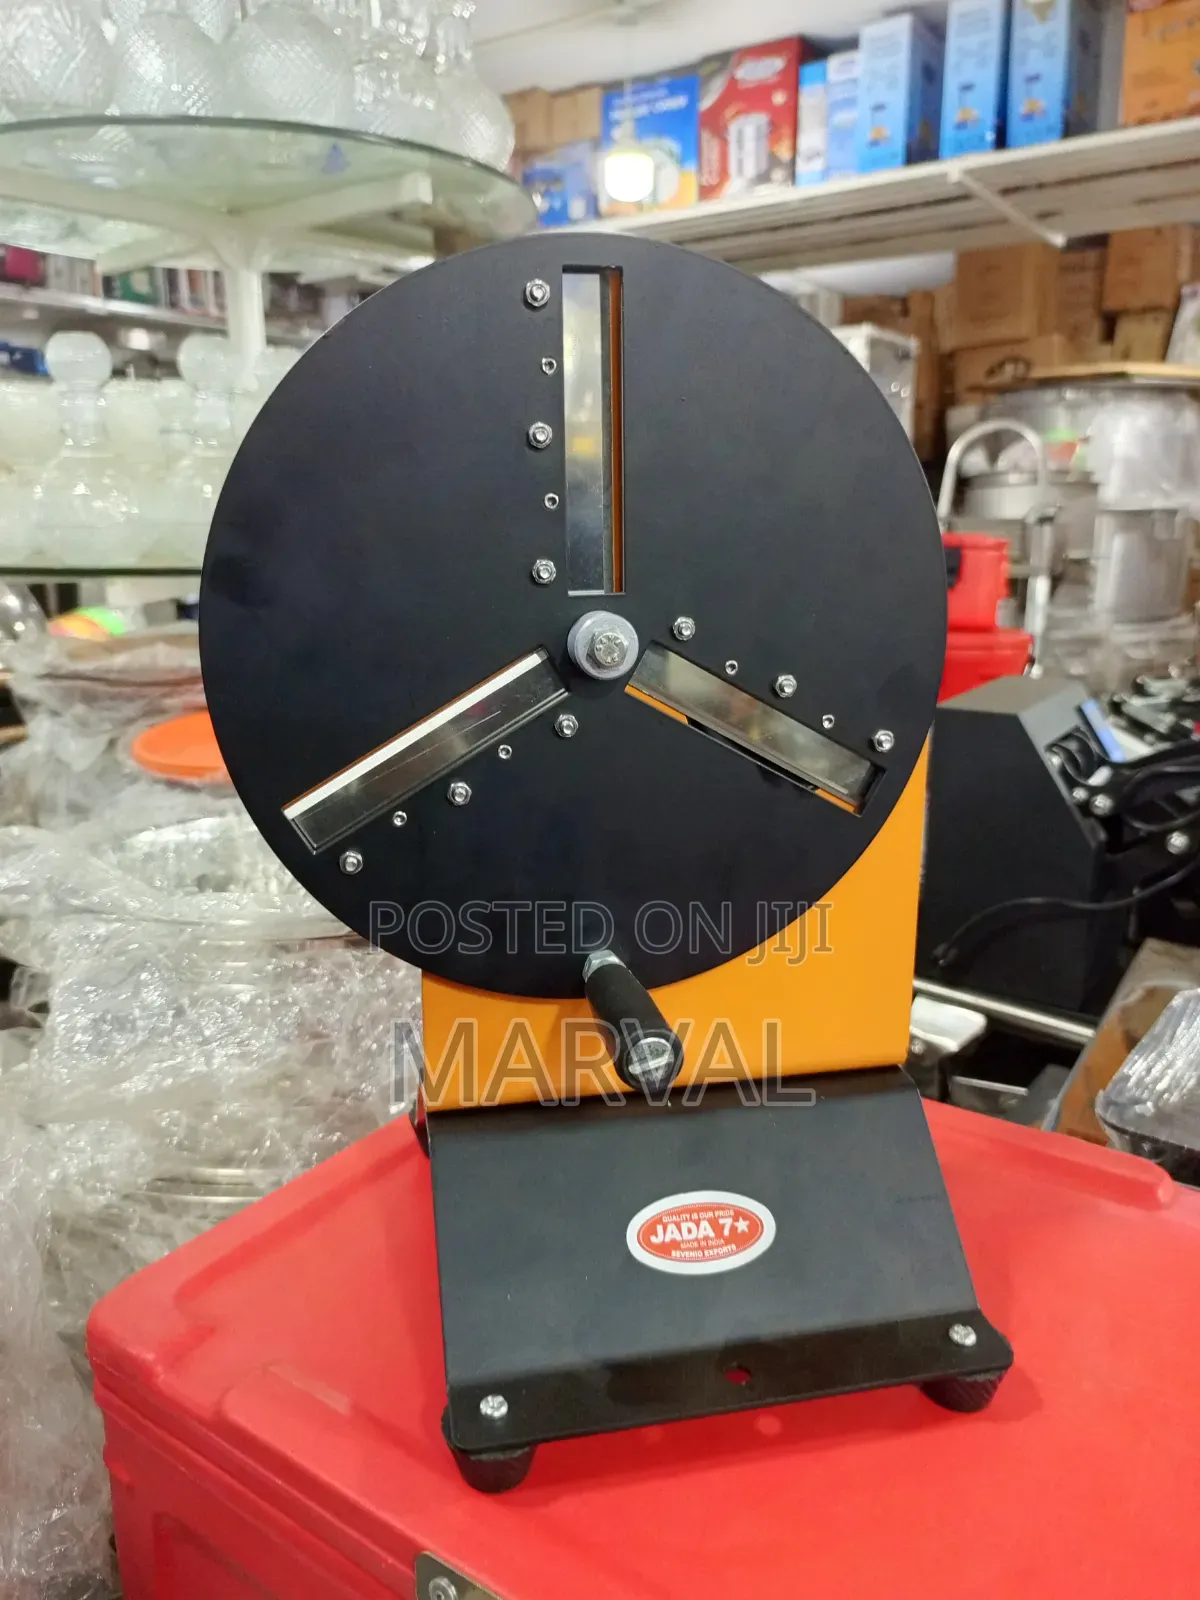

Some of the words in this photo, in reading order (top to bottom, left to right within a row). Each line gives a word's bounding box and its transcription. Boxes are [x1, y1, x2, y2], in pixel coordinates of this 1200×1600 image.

[662, 1215, 691, 1223] QUALITY
[699, 1211, 714, 1219] OUR
[715, 1209, 734, 1217] PRIDE
[650, 1220, 715, 1243] JADA
[719, 1217, 732, 1236] 7
[680, 1240, 699, 1249] MADE
[704, 1244, 737, 1257] EXPORTS
